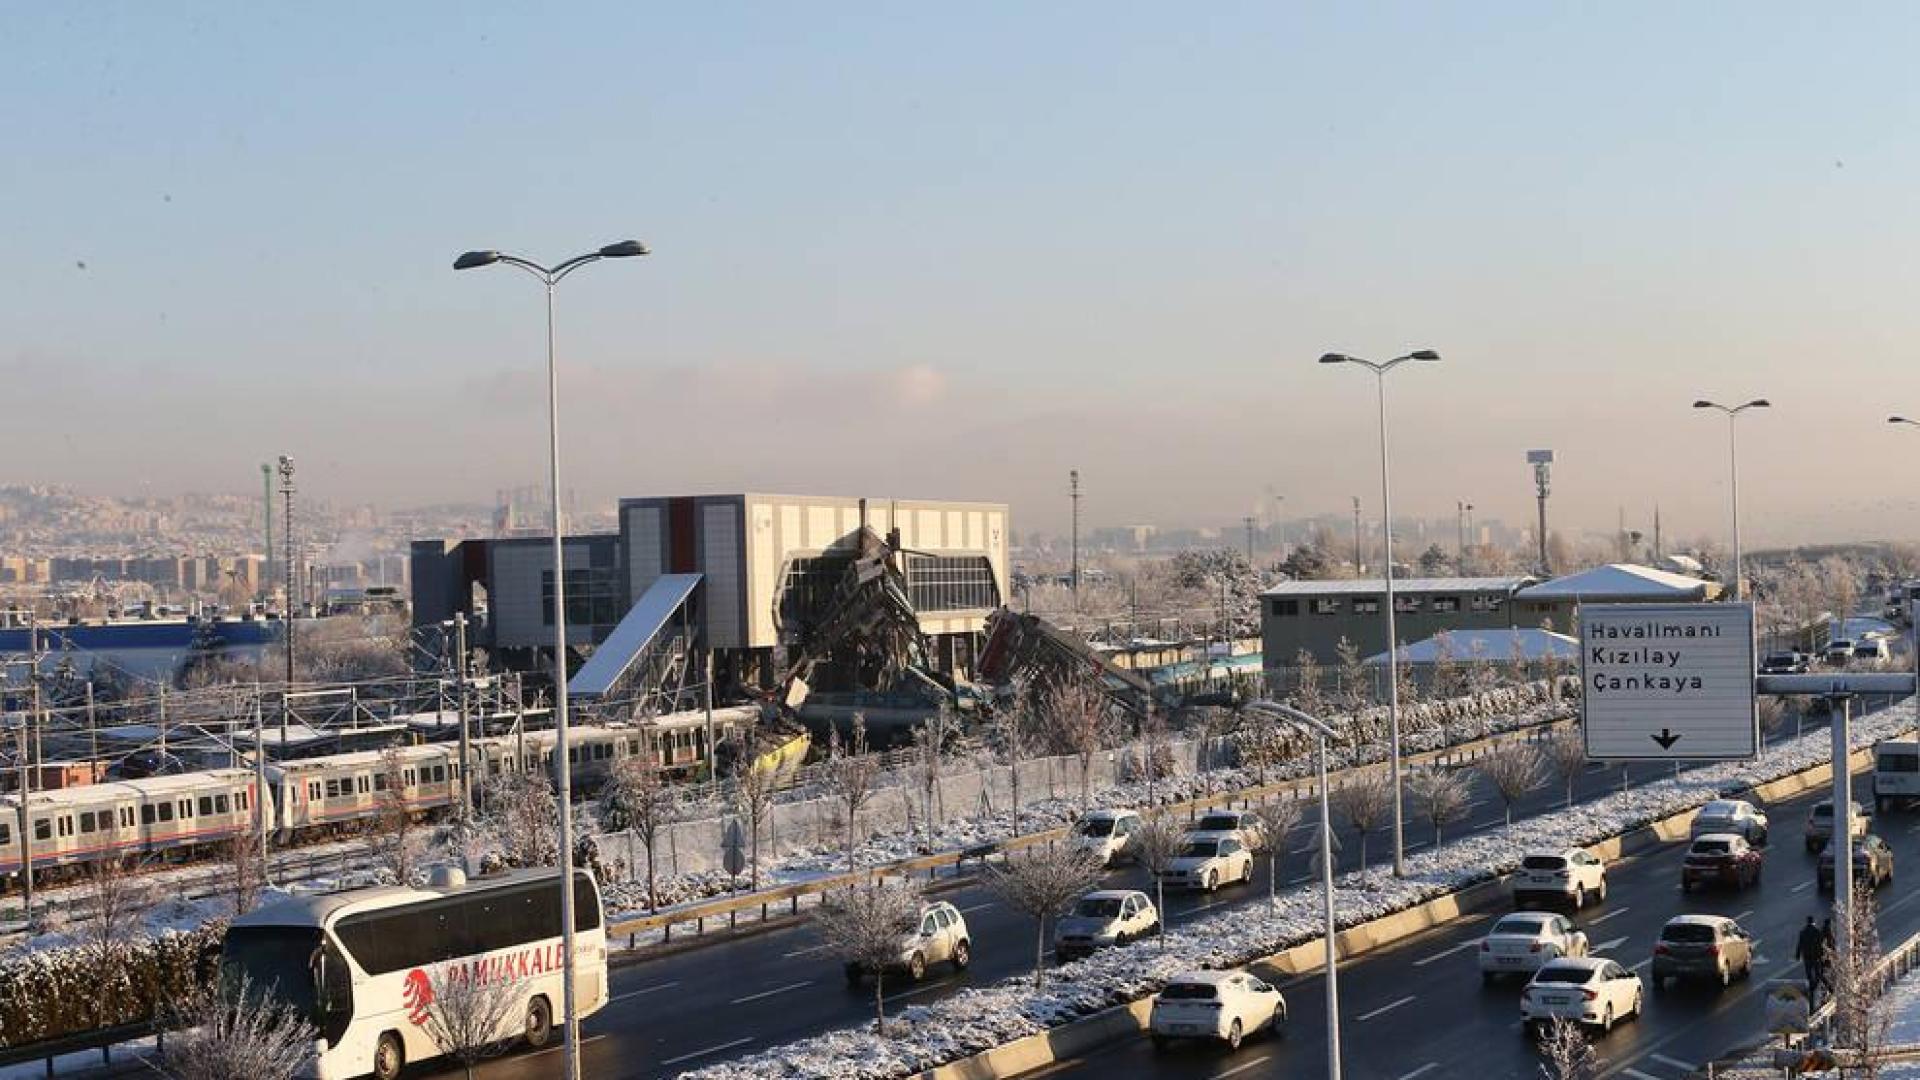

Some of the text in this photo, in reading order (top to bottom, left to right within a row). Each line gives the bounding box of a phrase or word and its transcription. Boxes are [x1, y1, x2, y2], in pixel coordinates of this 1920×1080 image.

[1592, 647, 1681, 667] Kızılay
[1593, 673, 1702, 693] Çankaya
[449, 943, 565, 989] PAMUKKALE
